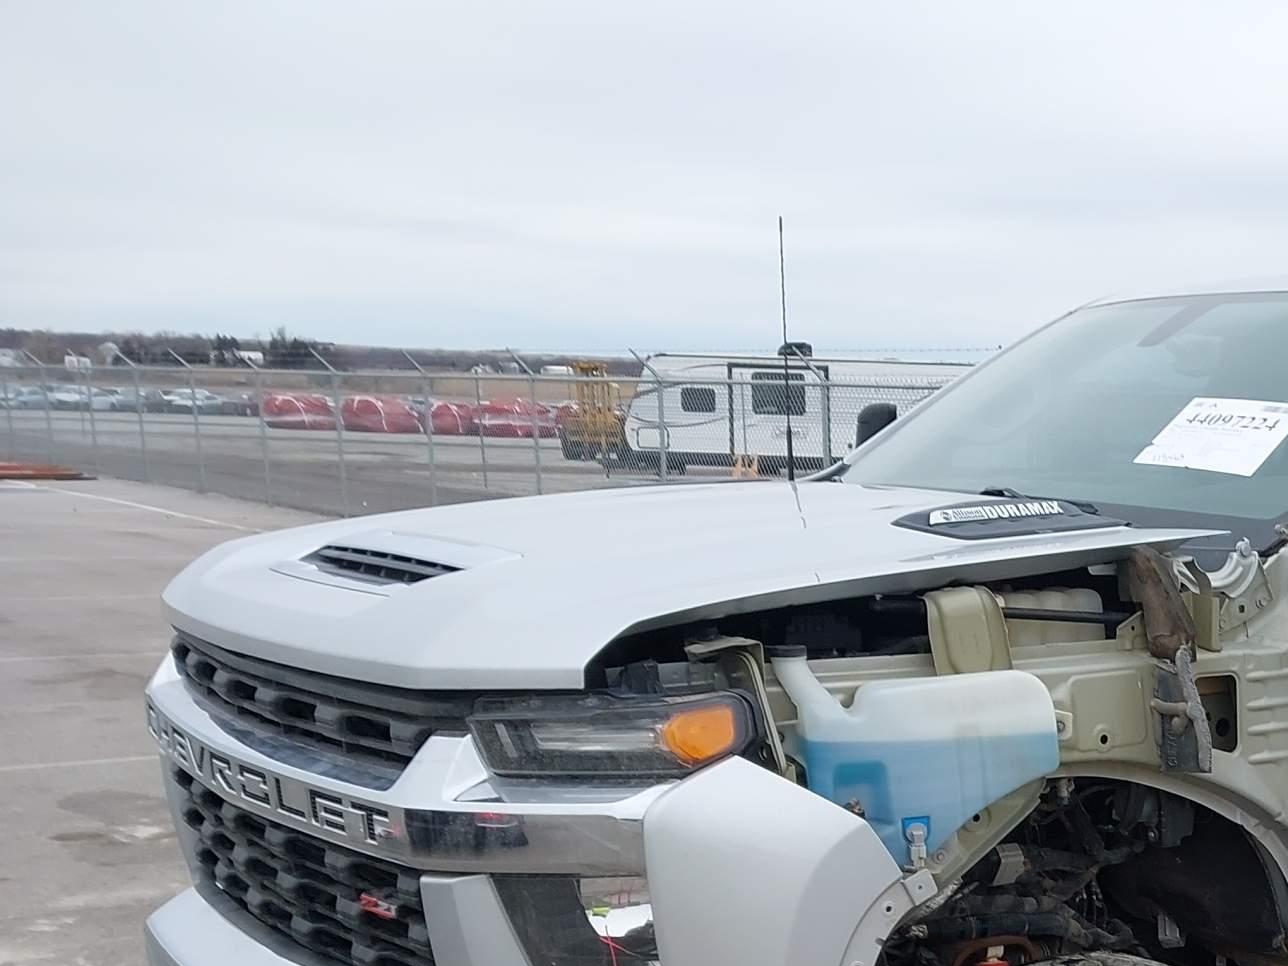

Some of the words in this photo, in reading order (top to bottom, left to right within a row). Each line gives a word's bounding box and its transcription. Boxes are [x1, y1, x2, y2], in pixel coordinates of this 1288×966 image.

[1186, 412, 1281, 432] 44097224
[984, 501, 1064, 520] DURAMAX
[148, 703, 390, 846] CHEVROLET
